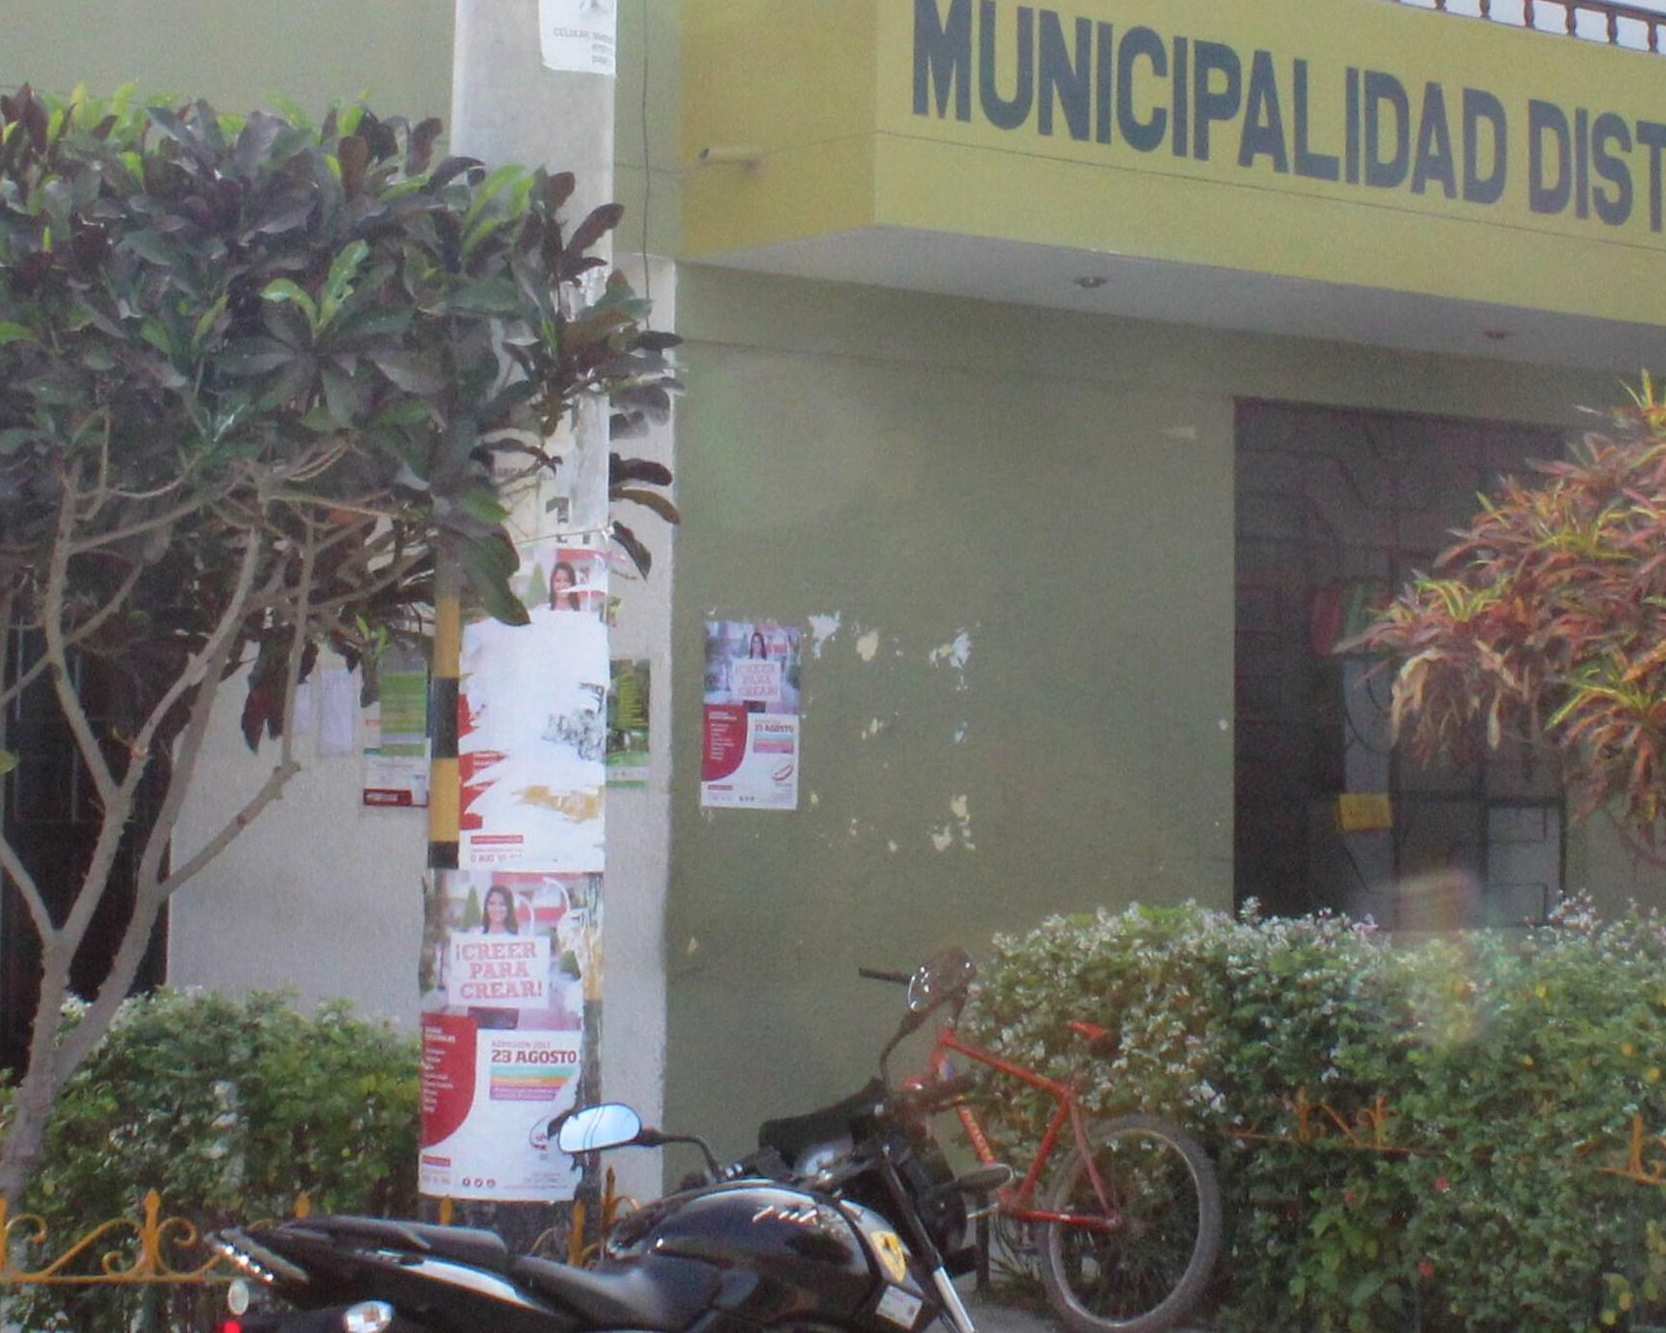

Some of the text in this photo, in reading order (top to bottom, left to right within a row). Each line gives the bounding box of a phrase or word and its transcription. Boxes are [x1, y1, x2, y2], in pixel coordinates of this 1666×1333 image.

[469, 961, 530, 979] PARA
[460, 980, 543, 1000] CREAR!
[491, 1049, 578, 1065] 23 AGOSTO
